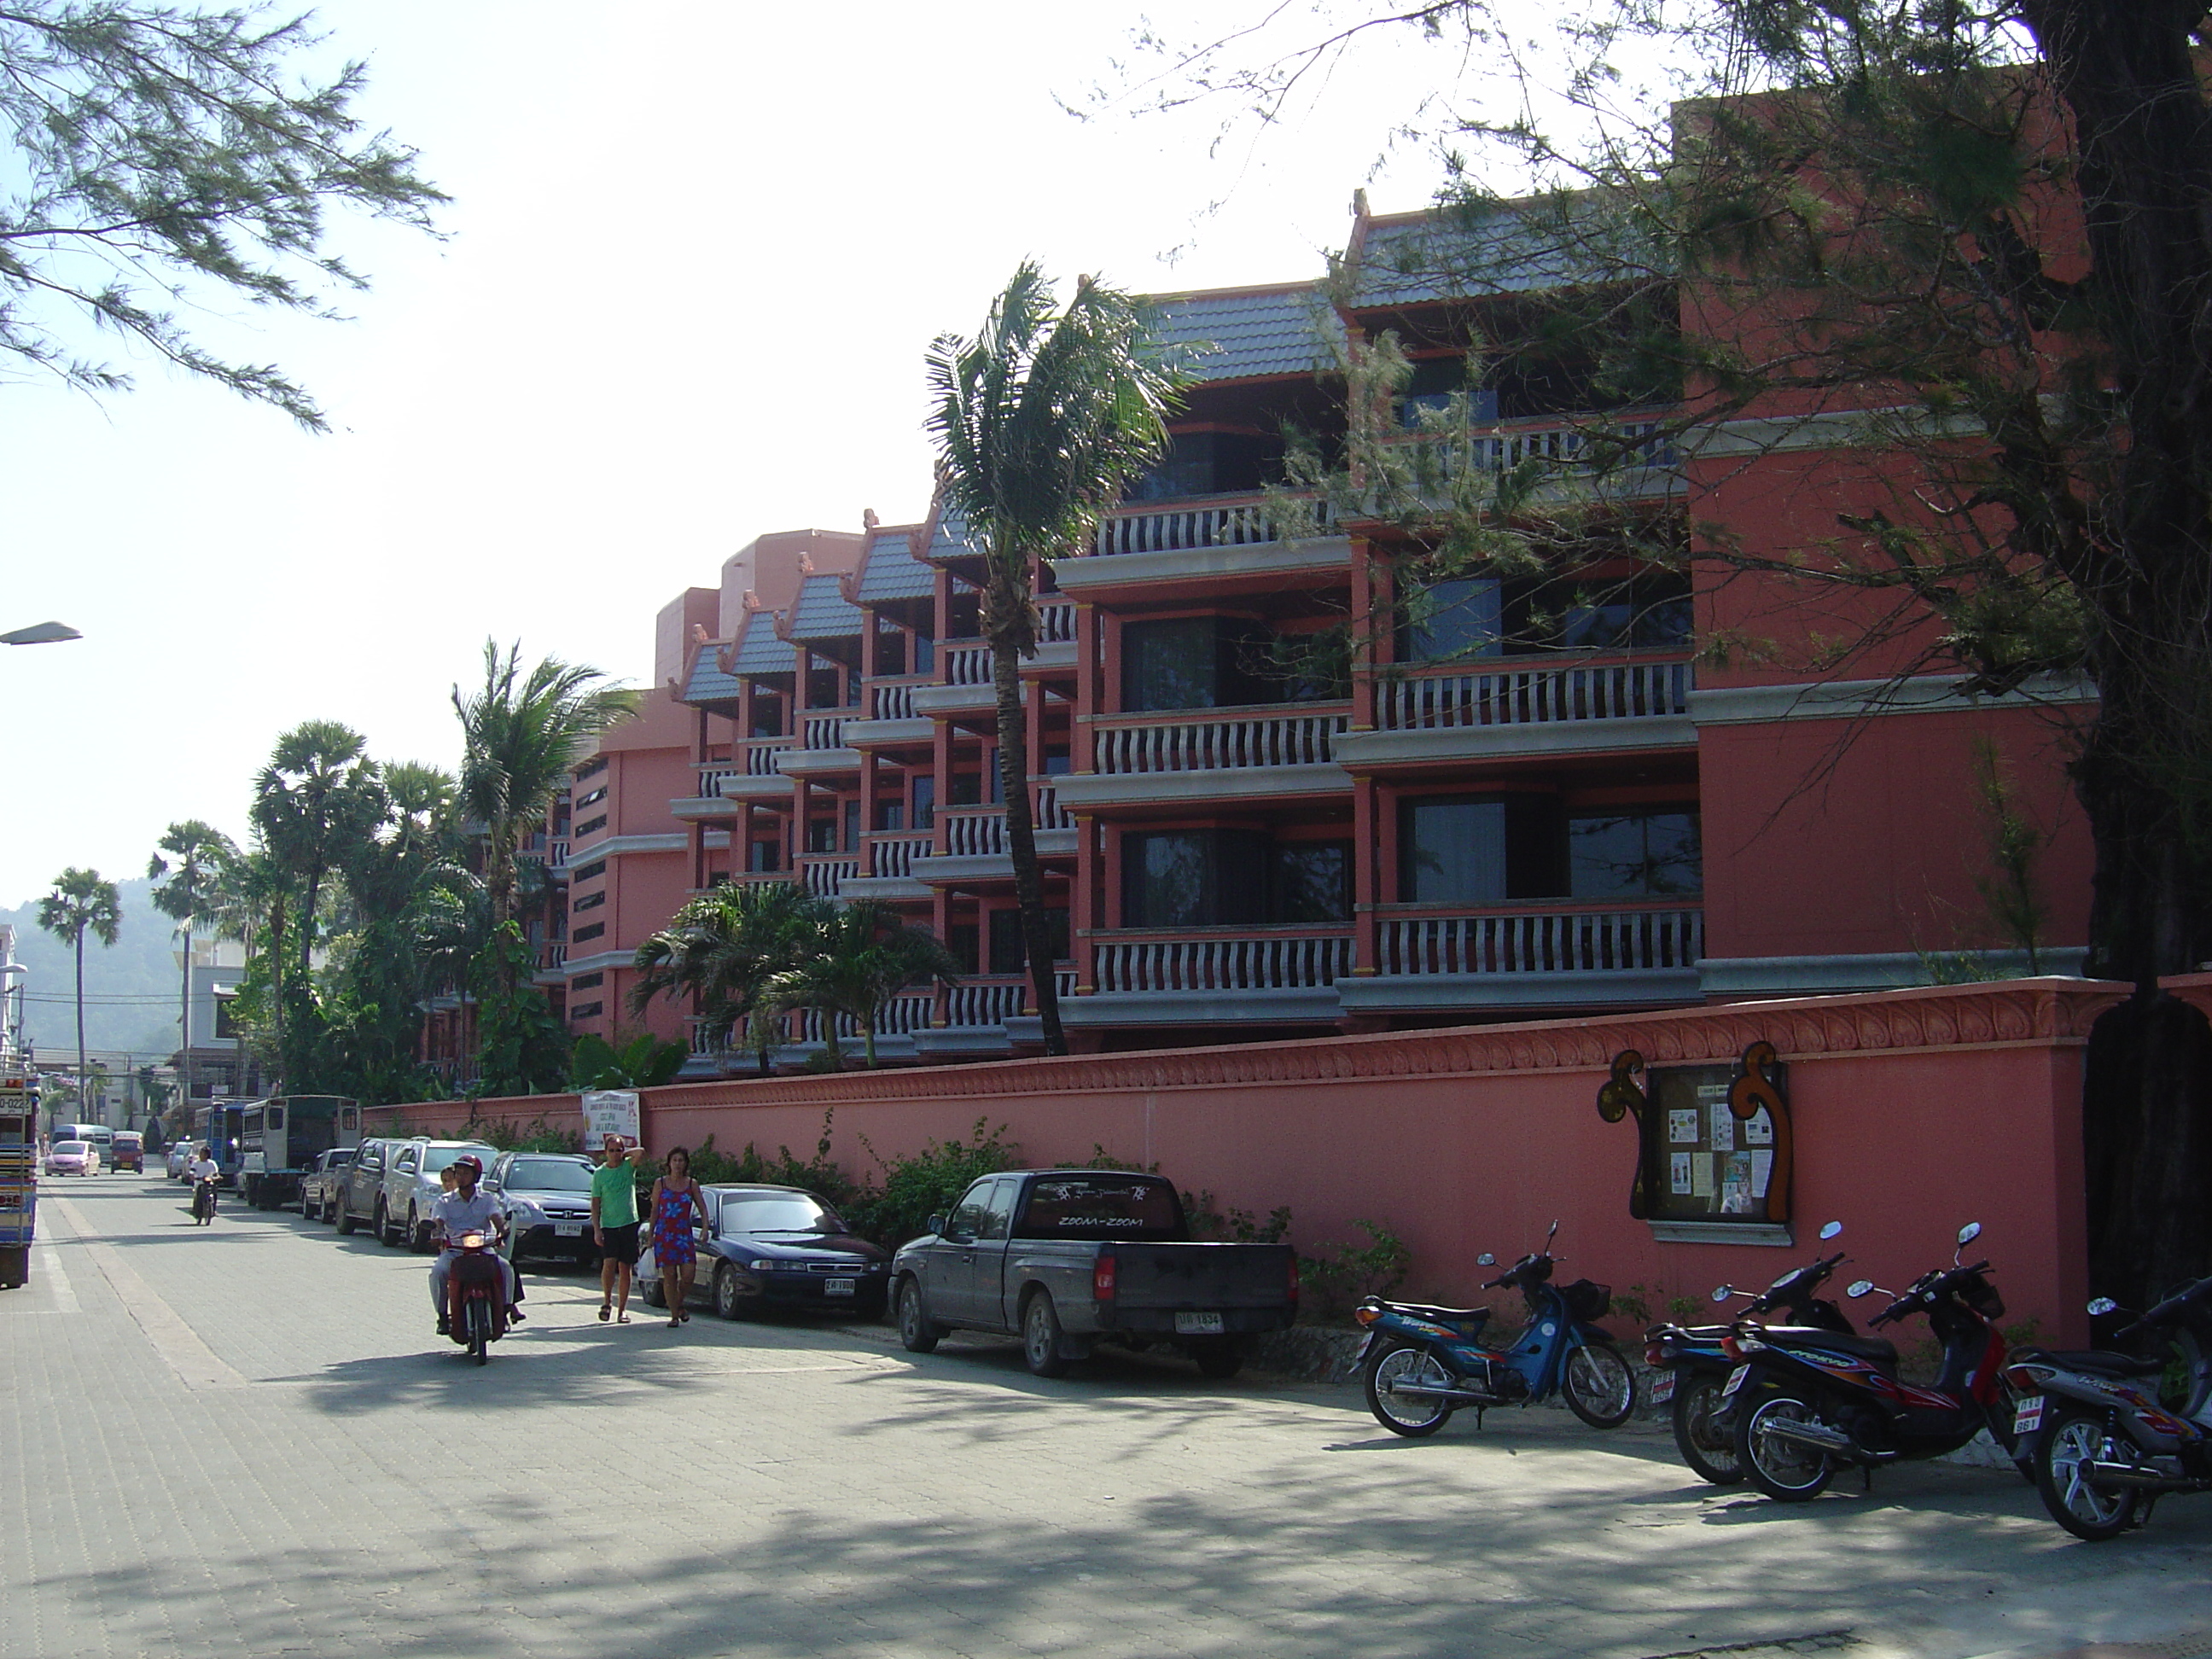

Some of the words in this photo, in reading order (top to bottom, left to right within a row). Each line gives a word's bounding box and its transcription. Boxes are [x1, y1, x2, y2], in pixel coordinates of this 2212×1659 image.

[1059, 1216, 1144, 1227] ZOOM-ZOOM
[1197, 1314, 1219, 1324] 1834
[2016, 1418, 2035, 1432] 961
